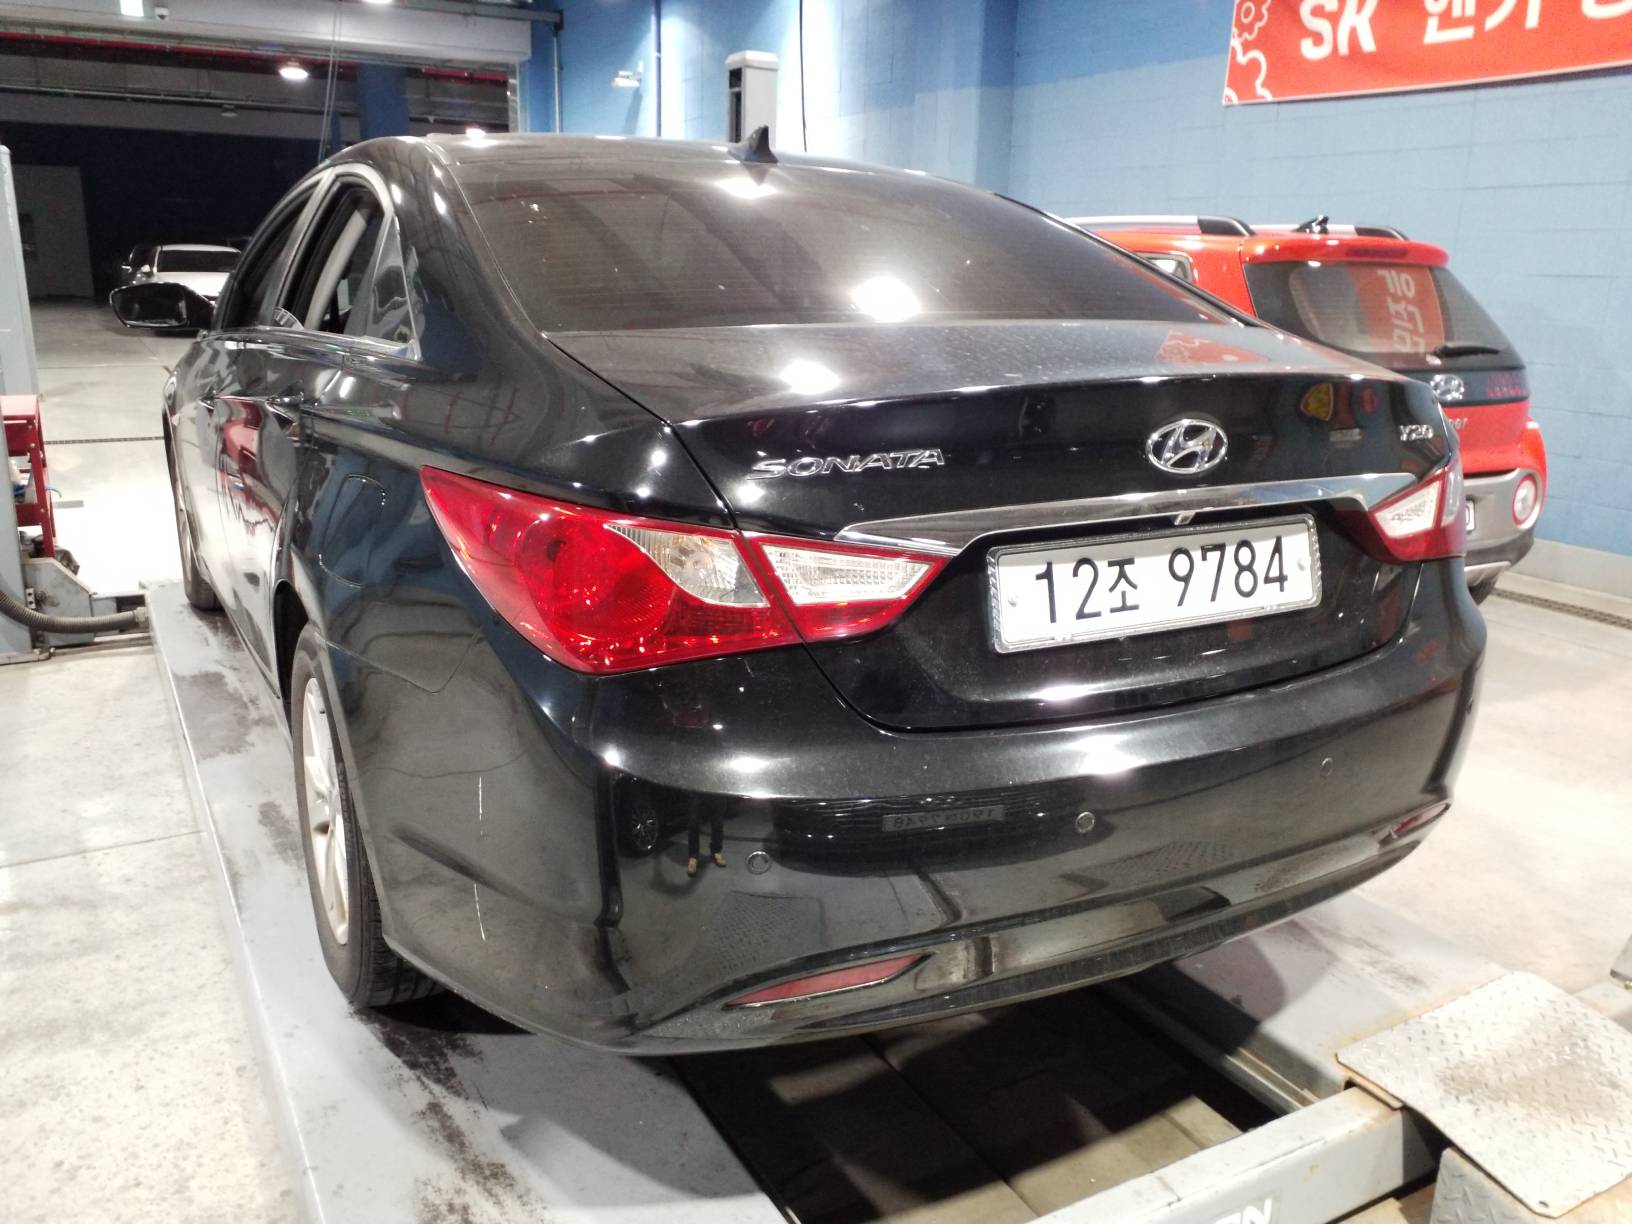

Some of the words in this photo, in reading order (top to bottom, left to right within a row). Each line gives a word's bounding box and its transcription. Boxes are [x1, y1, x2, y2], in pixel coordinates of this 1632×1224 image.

[1299, 0, 1379, 60] SK
[747, 448, 945, 480] SONATA
[1035, 557, 1140, 624] 12조
[1168, 535, 1289, 607] 9784
